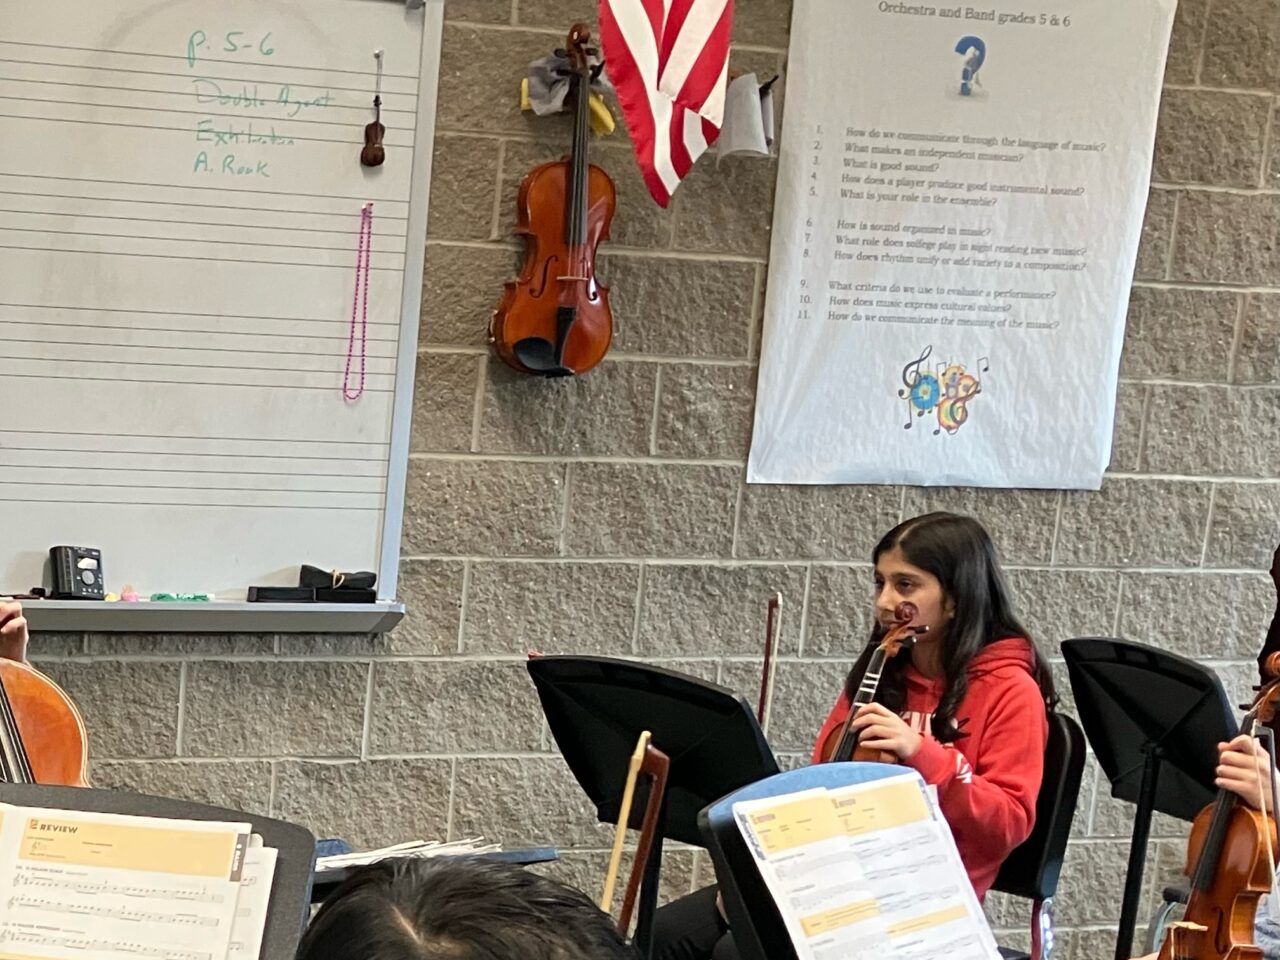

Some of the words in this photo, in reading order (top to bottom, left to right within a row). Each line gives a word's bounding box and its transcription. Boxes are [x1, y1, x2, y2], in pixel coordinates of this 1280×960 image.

[878, 1, 936, 16] Orchestra
[940, 7, 961, 18] and
[965, 8, 995, 21] Band
[998, 10, 1036, 24] grades
[1040, 14, 1046, 25] 5
[1050, 14, 1060, 26] &
[1063, 15, 1070, 26] 6
[846, 127, 866, 137] How
[869, 128, 880, 138] do
[897, 132, 960, 143] communicate
[962, 135, 998, 147] through
[1001, 137, 1016, 147] the
[1018, 138, 1058, 151] language
[1061, 141, 1072, 150] of
[1072, 142, 1106, 152] music?
[845, 143, 869, 152] What
[871, 145, 901, 155] makes
[904, 148, 916, 156] an
[918, 149, 975, 160] independent
[843, 158, 868, 168] What
[870, 159, 878, 169] is
[880, 161, 902, 172] good
[905, 162, 940, 172] sound?
[842, 174, 861, 184] How
[864, 175, 885, 185] does
[896, 177, 925, 188] player
[928, 180, 964, 190] produce
[966, 182, 988, 192] good
[990, 183, 1048, 195] instrumental
[1051, 186, 1085, 196] sound?
[840, 188, 864, 200] What
[866, 190, 875, 200] is
[878, 192, 899, 202] your
[901, 192, 919, 202] role
[921, 193, 930, 202] in
[934, 194, 948, 204] the
[837, 219, 856, 230] How
[860, 220, 868, 230] is
[870, 222, 900, 232] sound
[947, 226, 957, 235] in
[959, 227, 992, 236] music?
[836, 235, 859, 245] What
[862, 236, 880, 246] role
[883, 238, 904, 247] does
[938, 241, 957, 252] play
[960, 242, 969, 250] in
[994, 245, 1030, 256] reading
[1031, 247, 1050, 255] new
[1052, 248, 1087, 257] music?
[834, 250, 854, 261] How
[856, 252, 878, 262] does
[881, 253, 914, 264] rhythm
[916, 254, 940, 266] unify
[942, 257, 952, 265] or
[953, 257, 970, 266] add
[972, 258, 1000, 268] variety
[1004, 260, 1014, 268] to
[829, 281, 852, 291] What
[855, 282, 887, 292] criteria
[889, 284, 900, 293] do
[904, 286, 915, 294] we
[918, 286, 933, 294] use
[936, 286, 945, 295] to
[947, 286, 984, 297] evaluate
[829, 296, 850, 306] How
[853, 297, 874, 307] does
[876, 298, 902, 308] music
[904, 300, 938, 310] express
[941, 301, 976, 312] cultural
[828, 310, 849, 321] How
[852, 312, 862, 322] do
[865, 314, 876, 322] we
[878, 314, 939, 324] communicate
[941, 315, 954, 325] the
[957, 317, 996, 328] meaning
[998, 318, 1008, 328] of
[1009, 318, 1023, 328] the
[1026, 320, 1060, 330] music?
[40, 824, 79, 834] REVIEW
